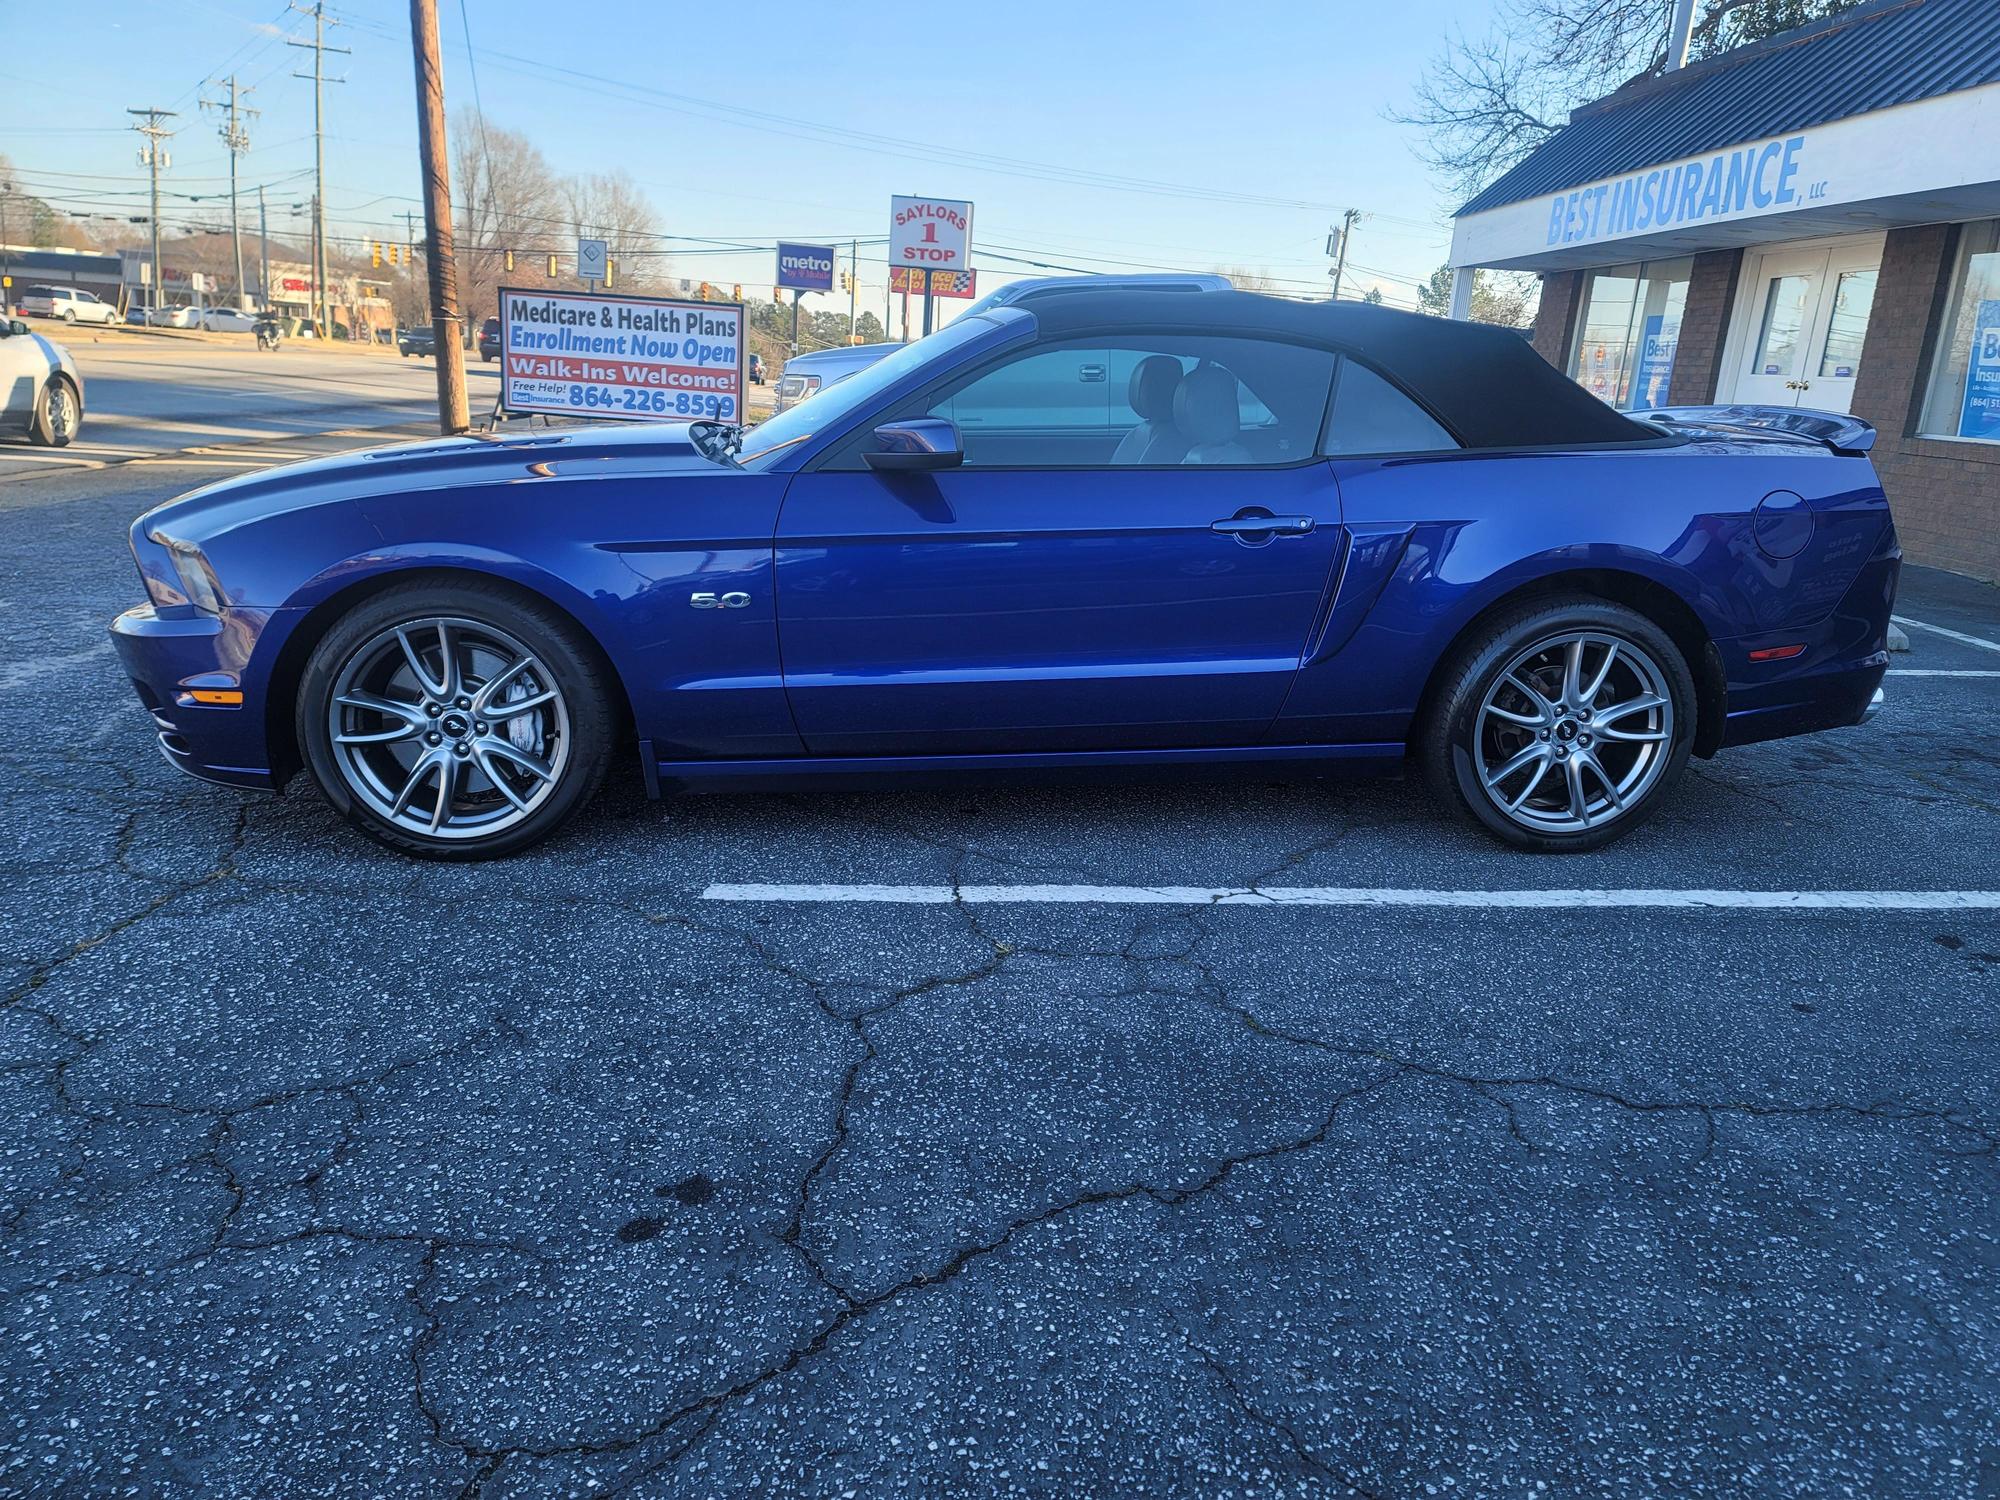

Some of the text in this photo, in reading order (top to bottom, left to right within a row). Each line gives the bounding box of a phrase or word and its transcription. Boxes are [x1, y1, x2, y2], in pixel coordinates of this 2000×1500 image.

[1547, 136, 1828, 246] BEST INSURANCE, LLC
[896, 204, 967, 231] SAYLORS
[920, 222, 939, 243] 1
[782, 255, 831, 272] metro
[904, 246, 956, 262] STOP
[900, 267, 952, 282] Advnce
[511, 299, 736, 337] Medicare & Health Plans
[510, 325, 736, 366] Enrollment Now Open
[1647, 339, 1669, 357] Best
[1984, 333, 2000, 359] B
[510, 357, 736, 390] Walk-Ins Welcome!
[513, 381, 566, 394] Free Help!
[531, 394, 565, 404] Insurance
[569, 385, 735, 418] 864-226-8599
[690, 592, 751, 609] 5.0
